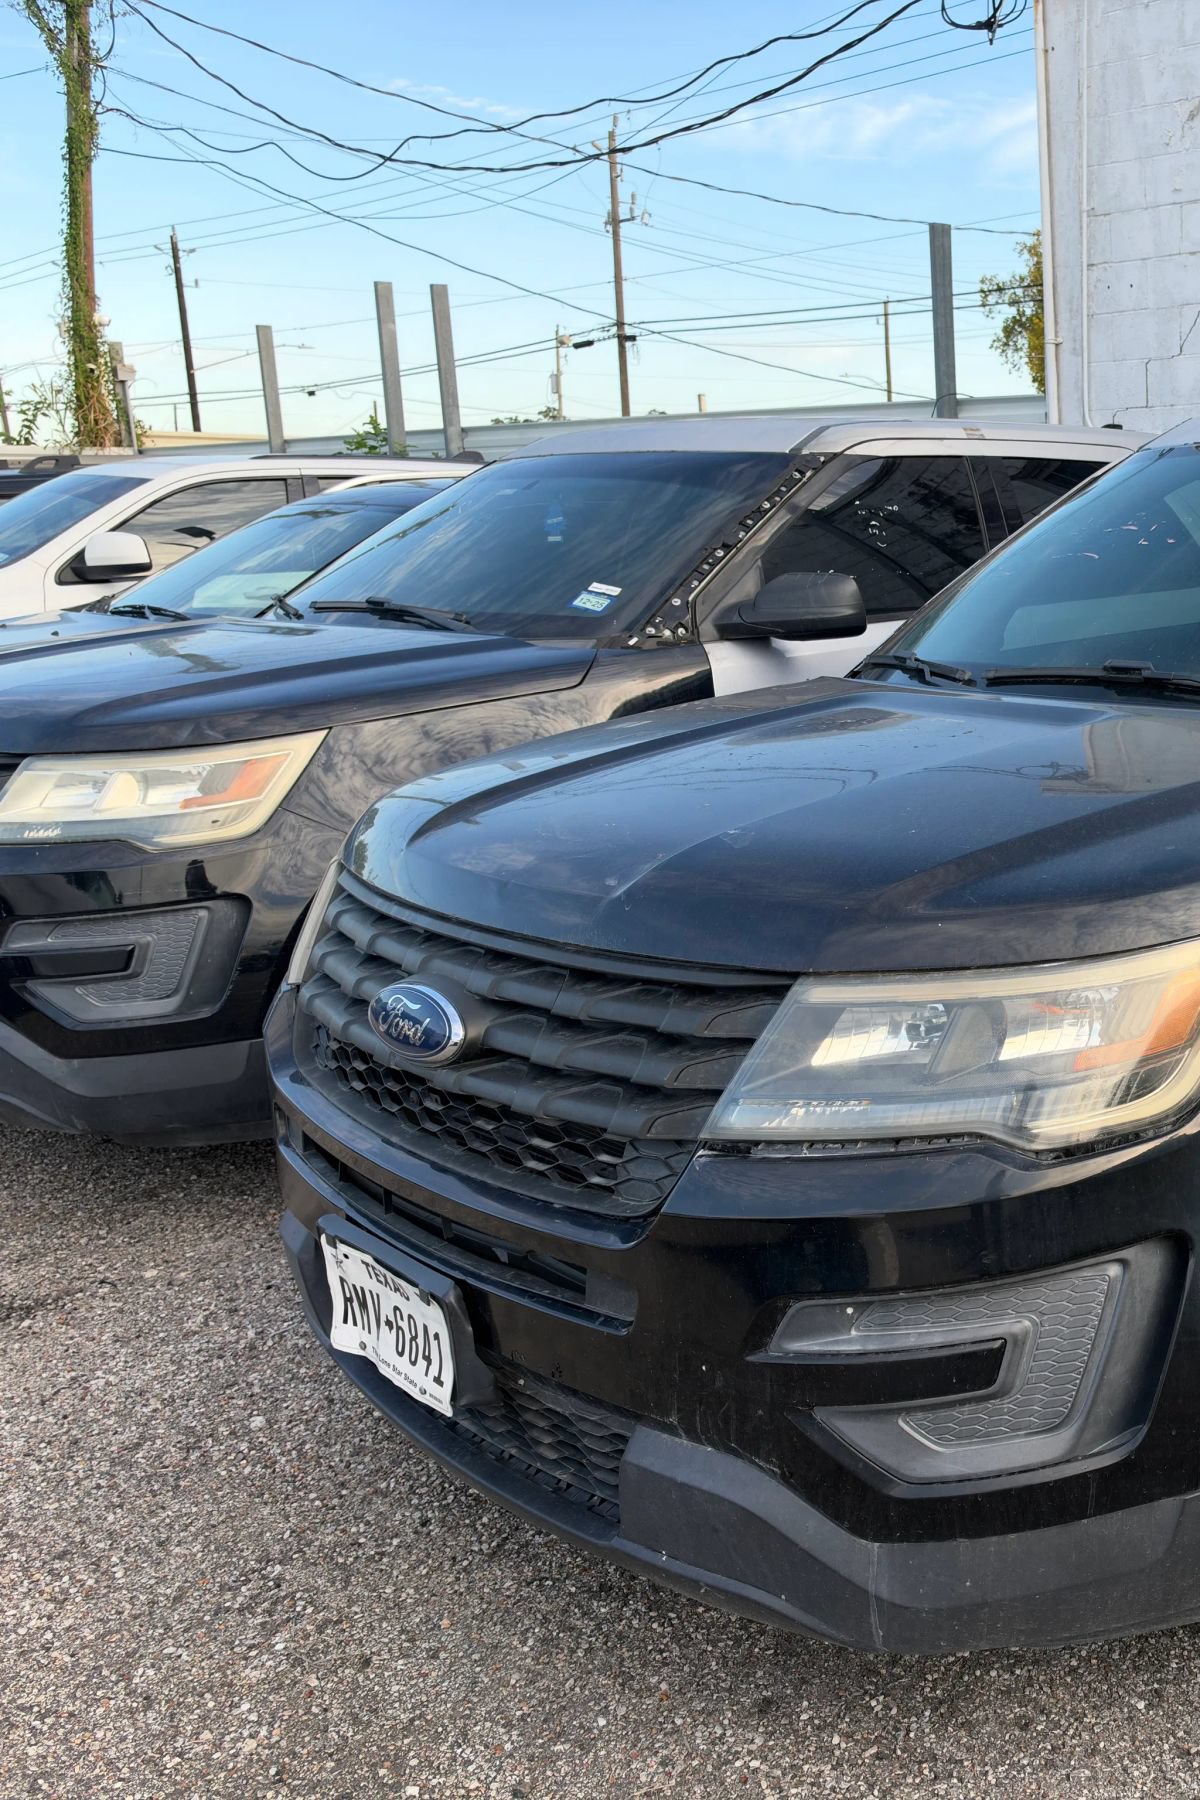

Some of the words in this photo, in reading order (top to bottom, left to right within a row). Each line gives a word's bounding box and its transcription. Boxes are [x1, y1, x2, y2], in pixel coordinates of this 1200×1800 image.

[378, 994, 431, 1047] Ford
[360, 1259, 411, 1302] TEXAS
[339, 1275, 382, 1342] RMV
[393, 1305, 445, 1388] 6841
[378, 1353, 391, 1369] Lone
[391, 1363, 404, 1377] Star
[403, 1372, 418, 1389] State
